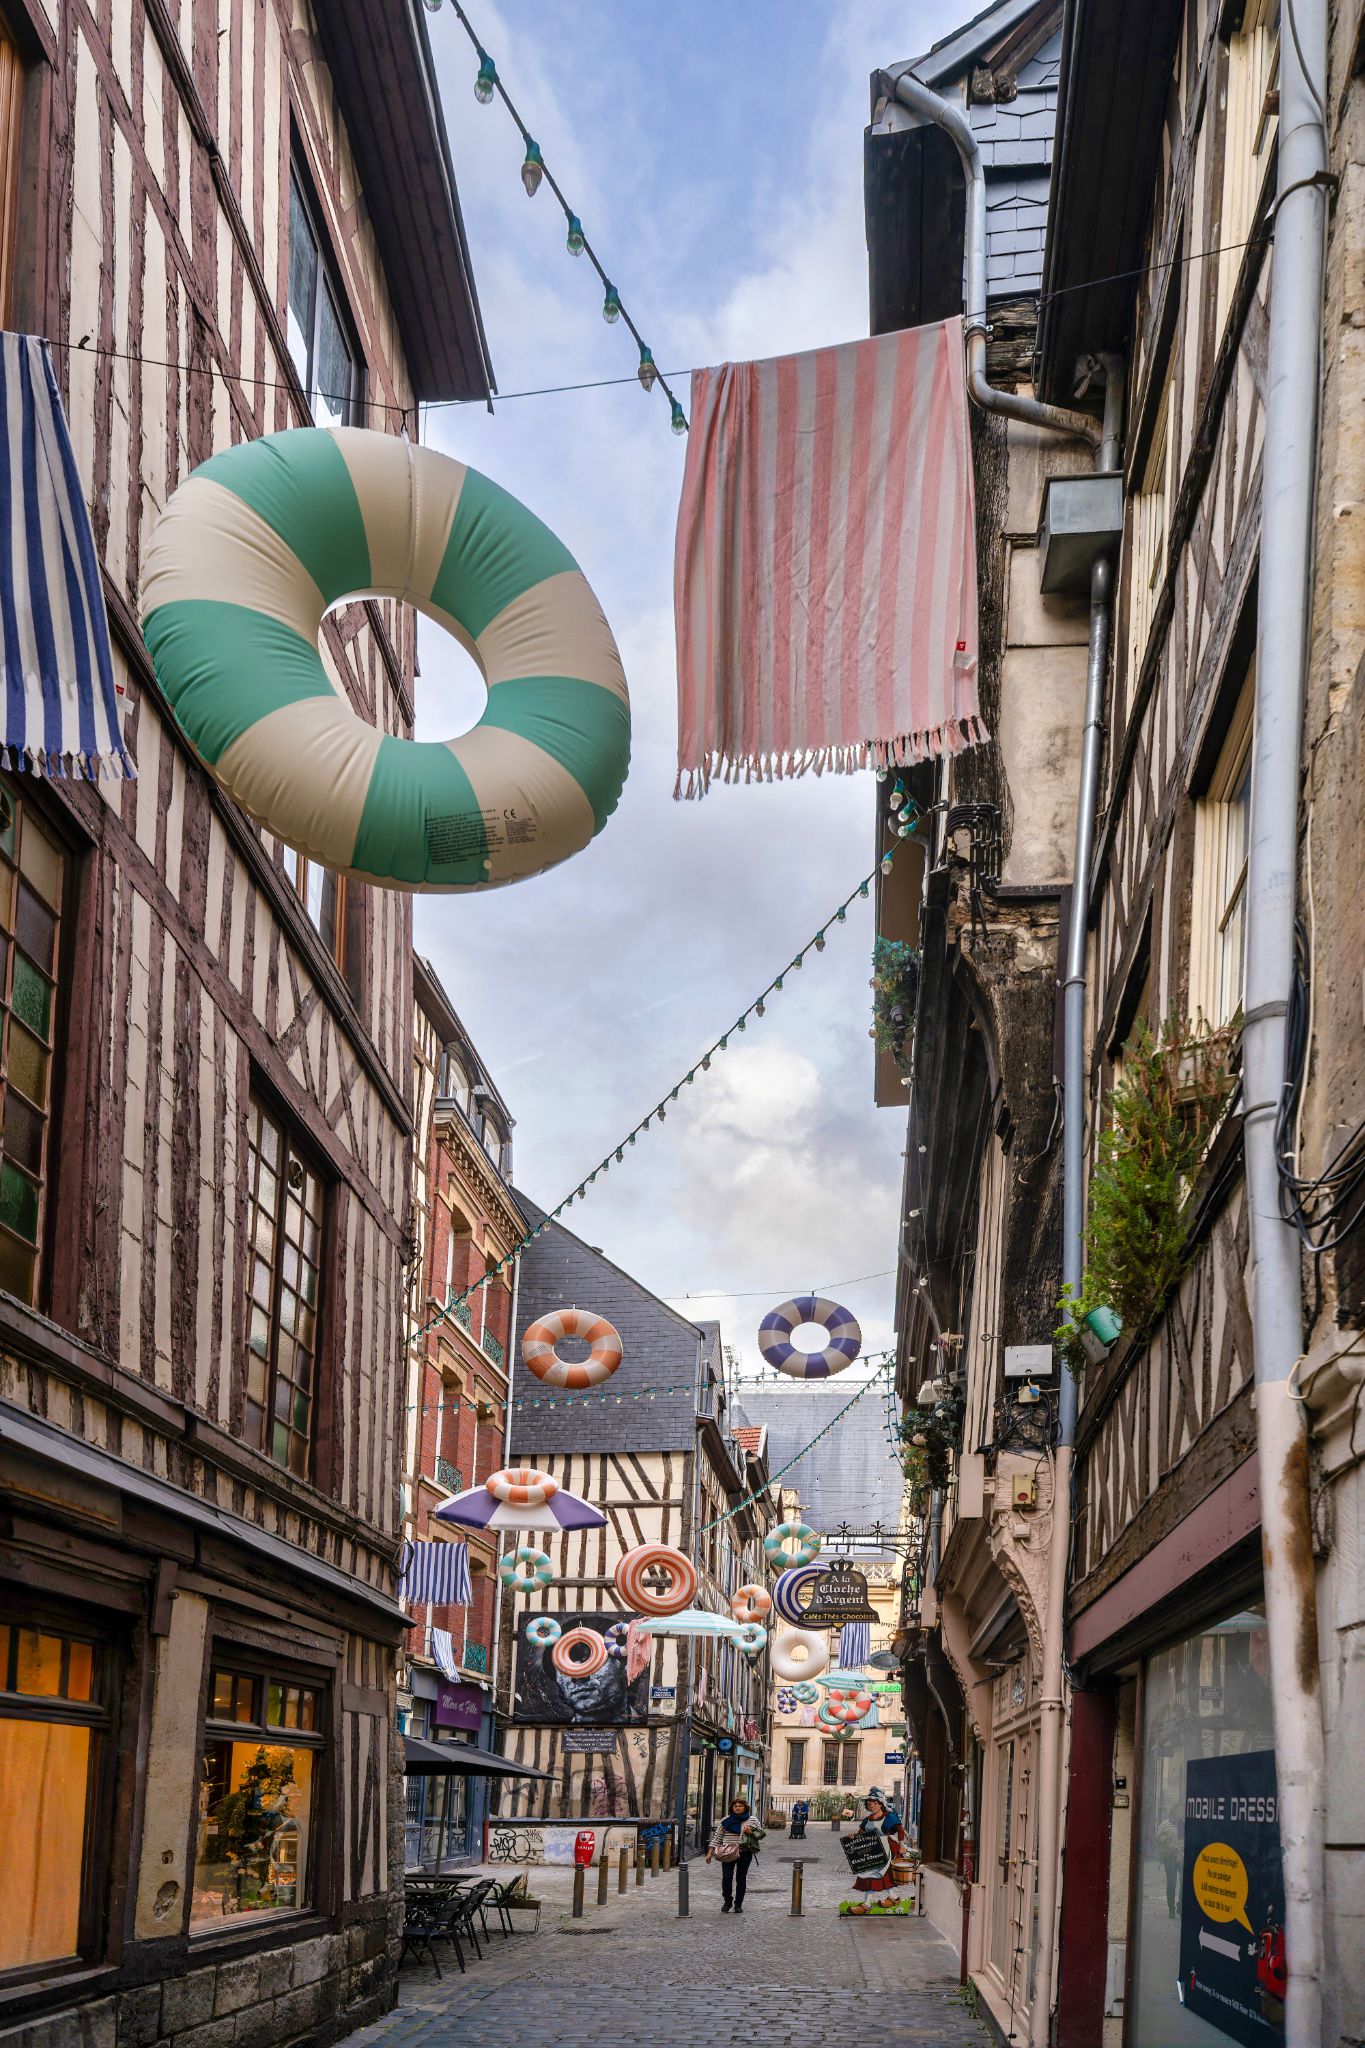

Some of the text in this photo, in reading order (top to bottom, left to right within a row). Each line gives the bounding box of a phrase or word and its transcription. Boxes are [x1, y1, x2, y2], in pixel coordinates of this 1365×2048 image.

[820, 1584, 861, 1595] Cloche
[815, 1594, 865, 1606] d'Argent
[465, 1700, 478, 1715] Fille
[1186, 1797, 1226, 1820] MOBILE
